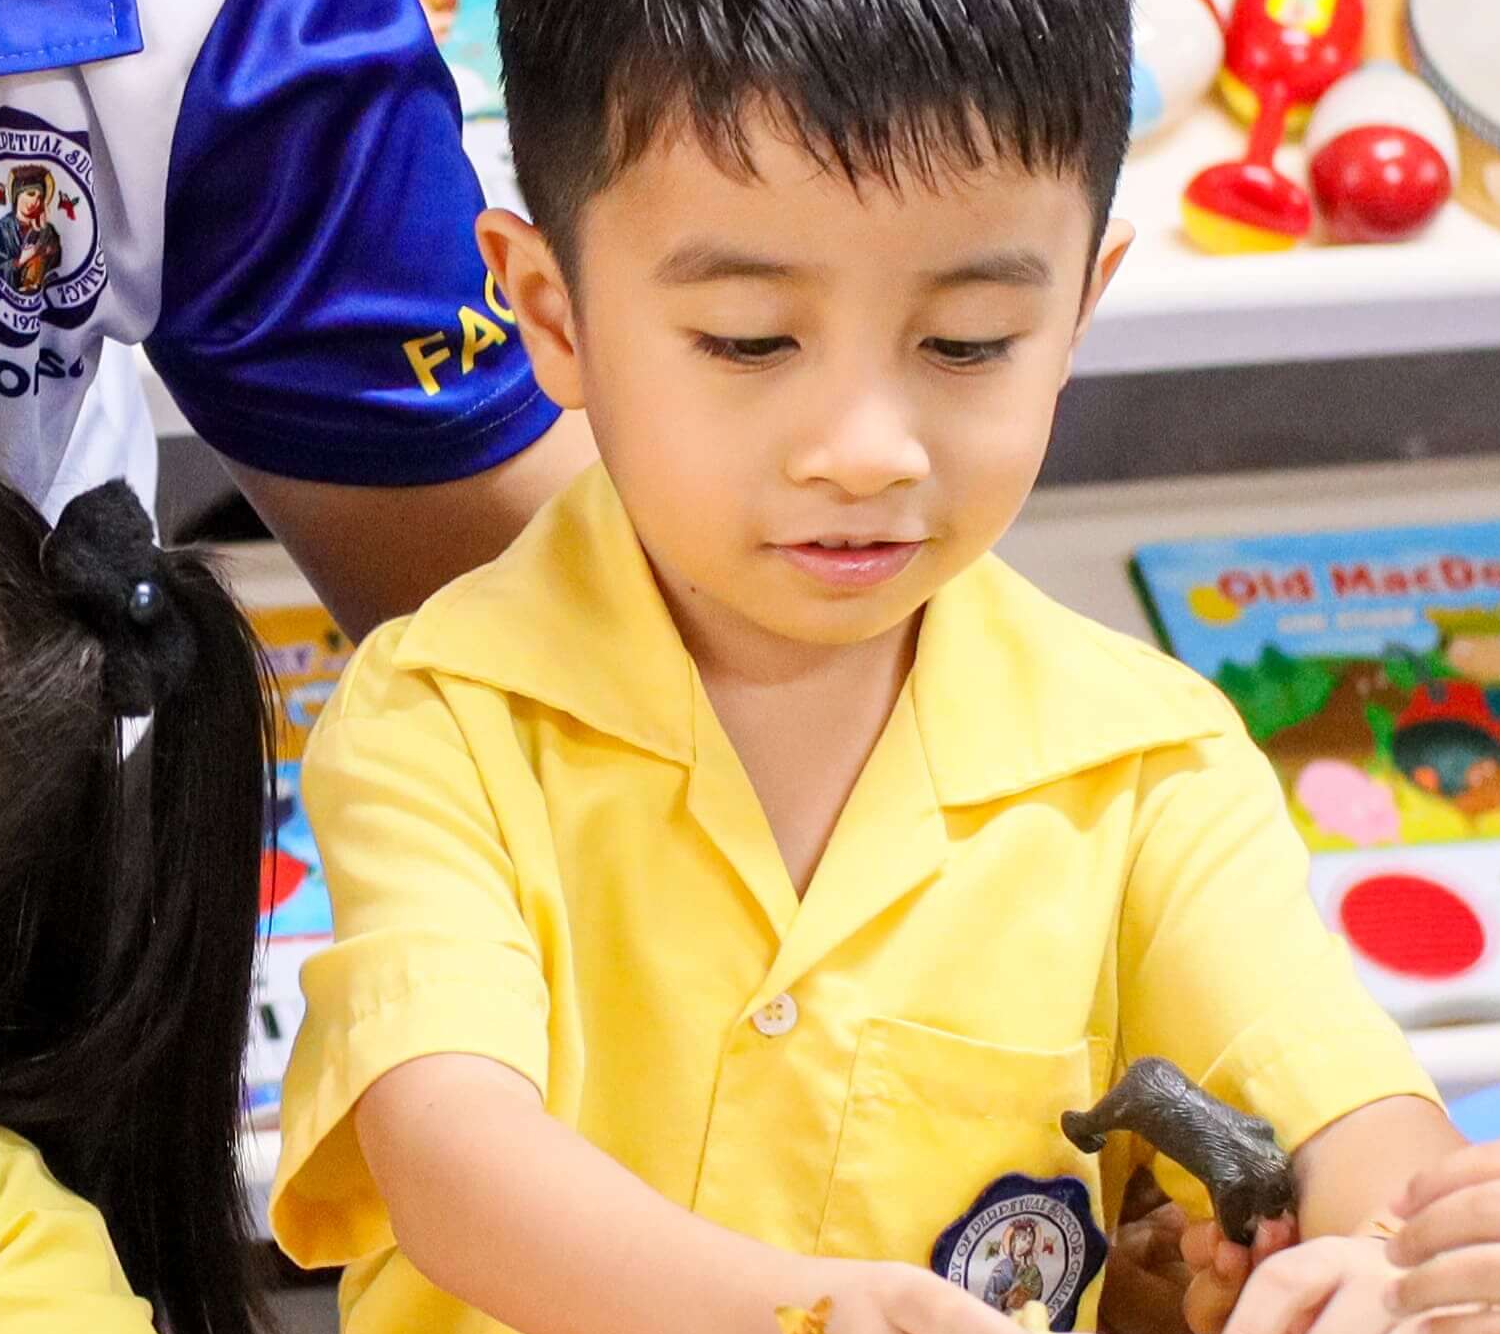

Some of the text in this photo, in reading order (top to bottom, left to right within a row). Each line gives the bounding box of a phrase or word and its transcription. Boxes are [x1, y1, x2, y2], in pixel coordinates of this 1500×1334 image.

[1217, 568, 1314, 605] Old
[957, 1232, 972, 1257] OF
[971, 1199, 1048, 1236] PERPETUAL
